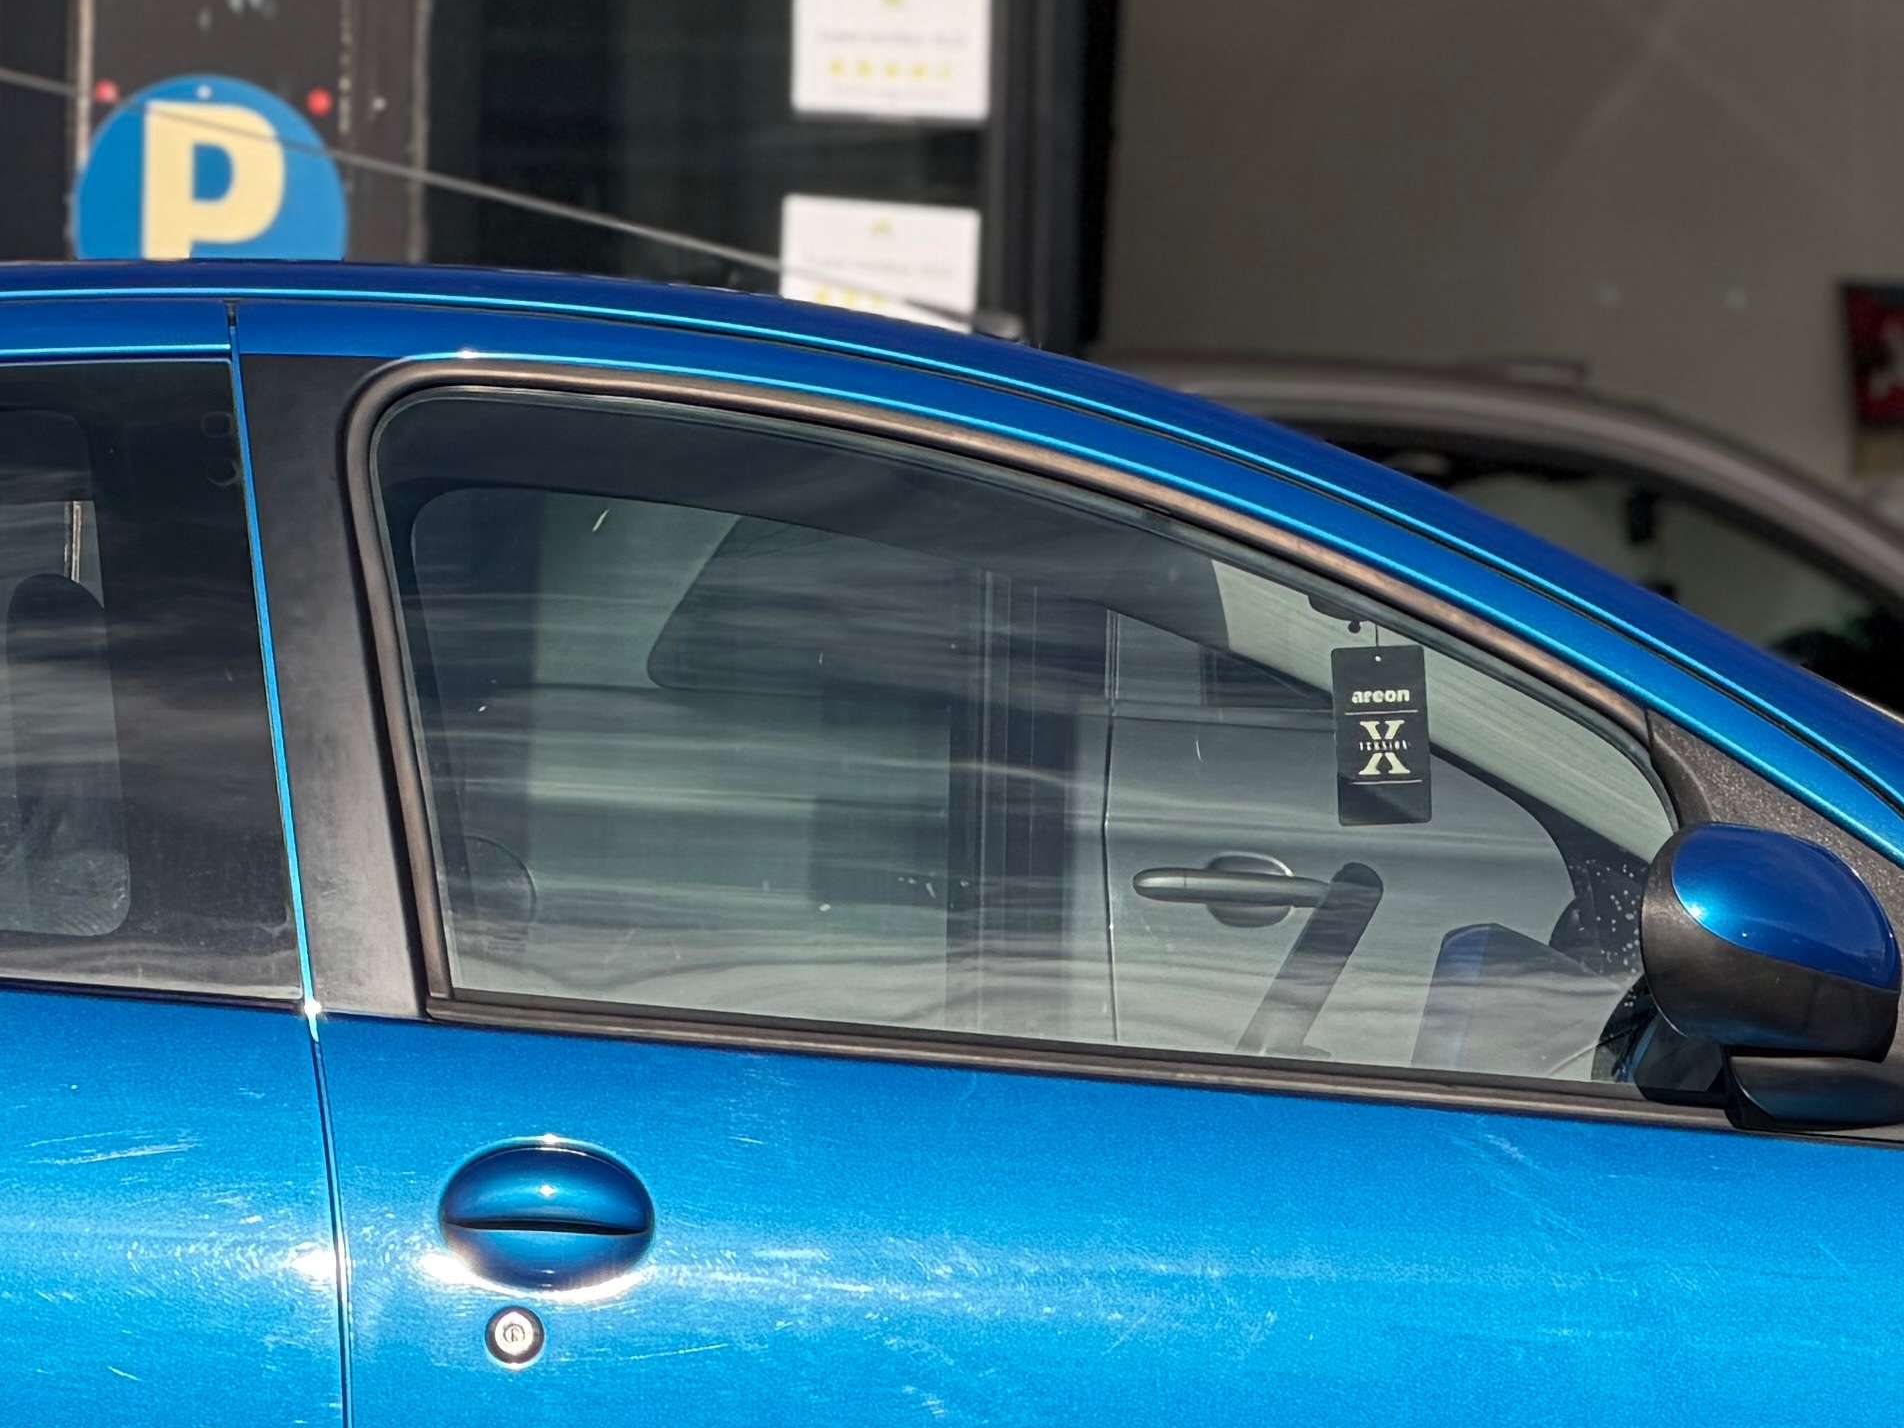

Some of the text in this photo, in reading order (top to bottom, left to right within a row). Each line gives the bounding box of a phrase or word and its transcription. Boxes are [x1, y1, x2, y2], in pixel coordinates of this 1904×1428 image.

[142, 98, 287, 260] P
[1351, 688, 1412, 705] areon
[1358, 719, 1412, 776] X
